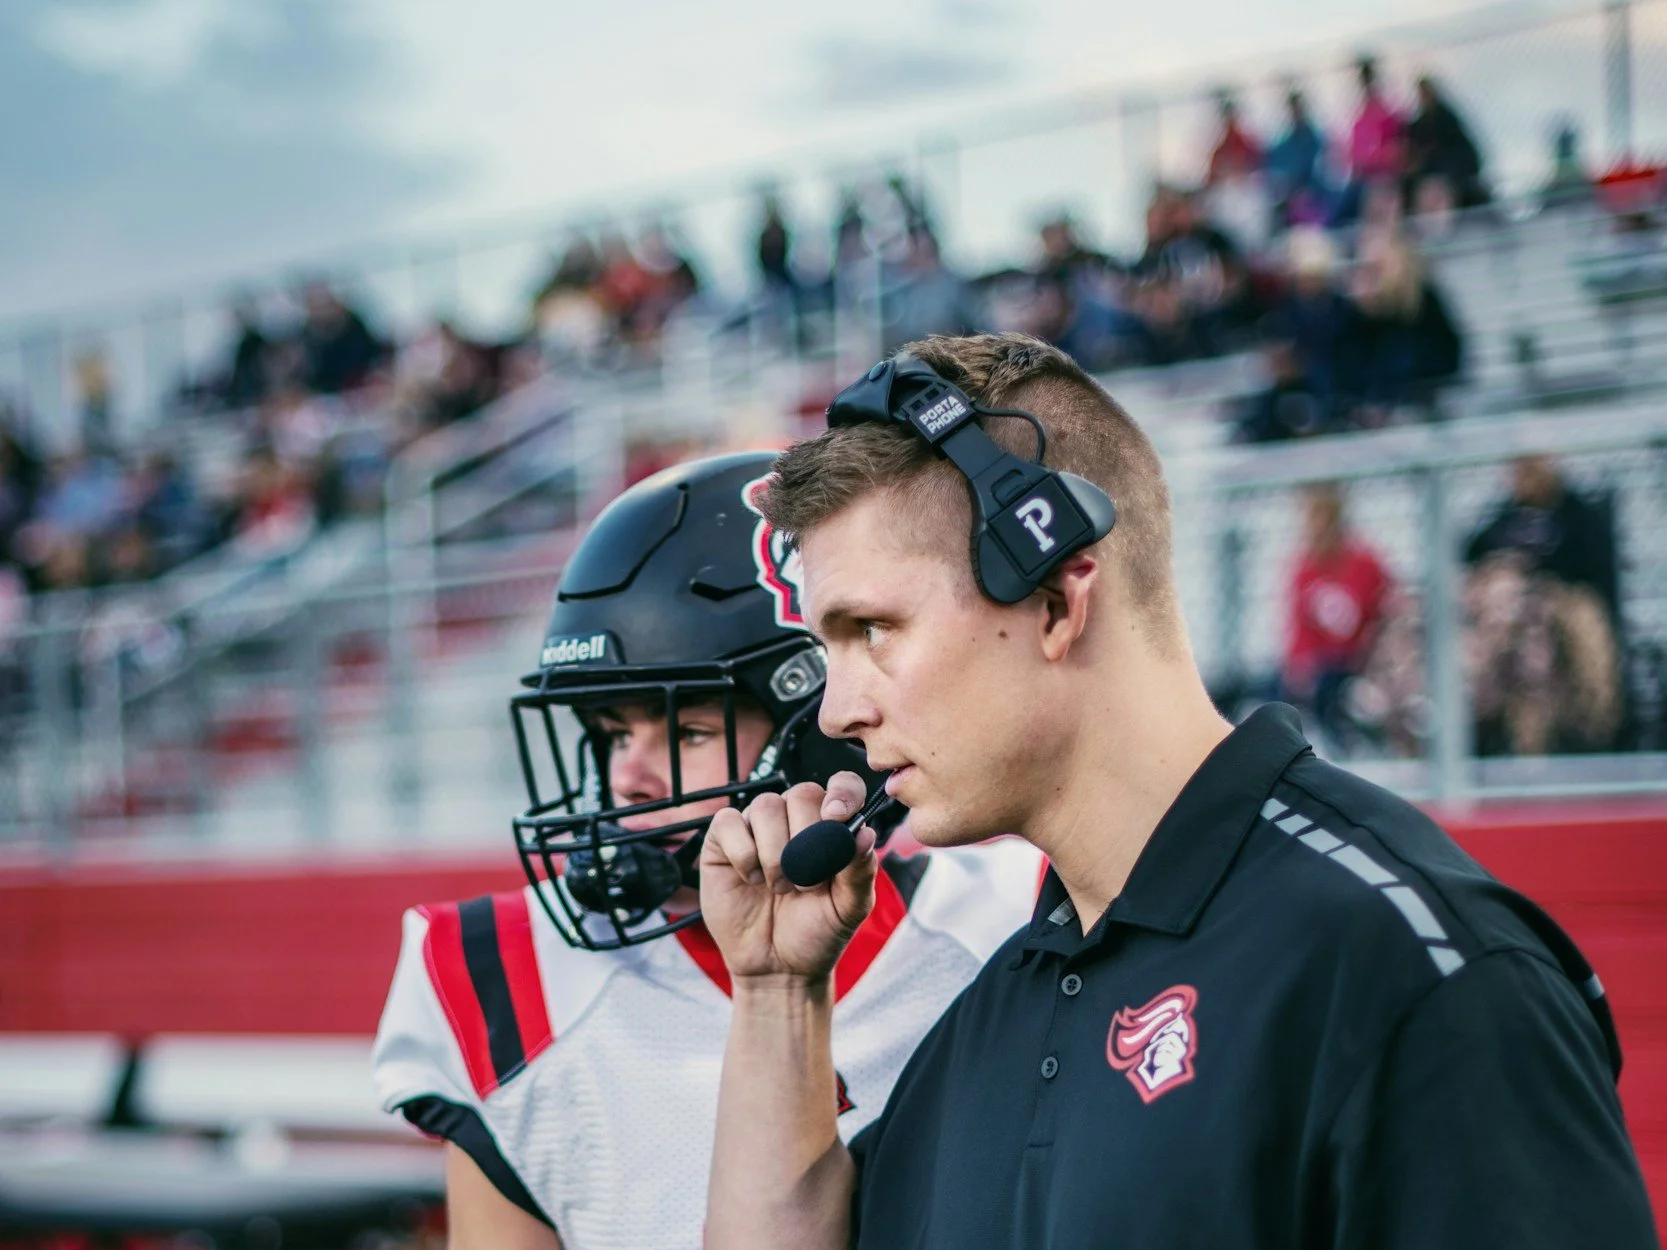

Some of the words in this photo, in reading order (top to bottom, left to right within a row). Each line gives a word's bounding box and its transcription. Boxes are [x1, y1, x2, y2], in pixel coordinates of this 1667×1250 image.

[919, 396, 959, 425] PORTA
[926, 402, 967, 434] PHONE
[1015, 498, 1055, 552] P
